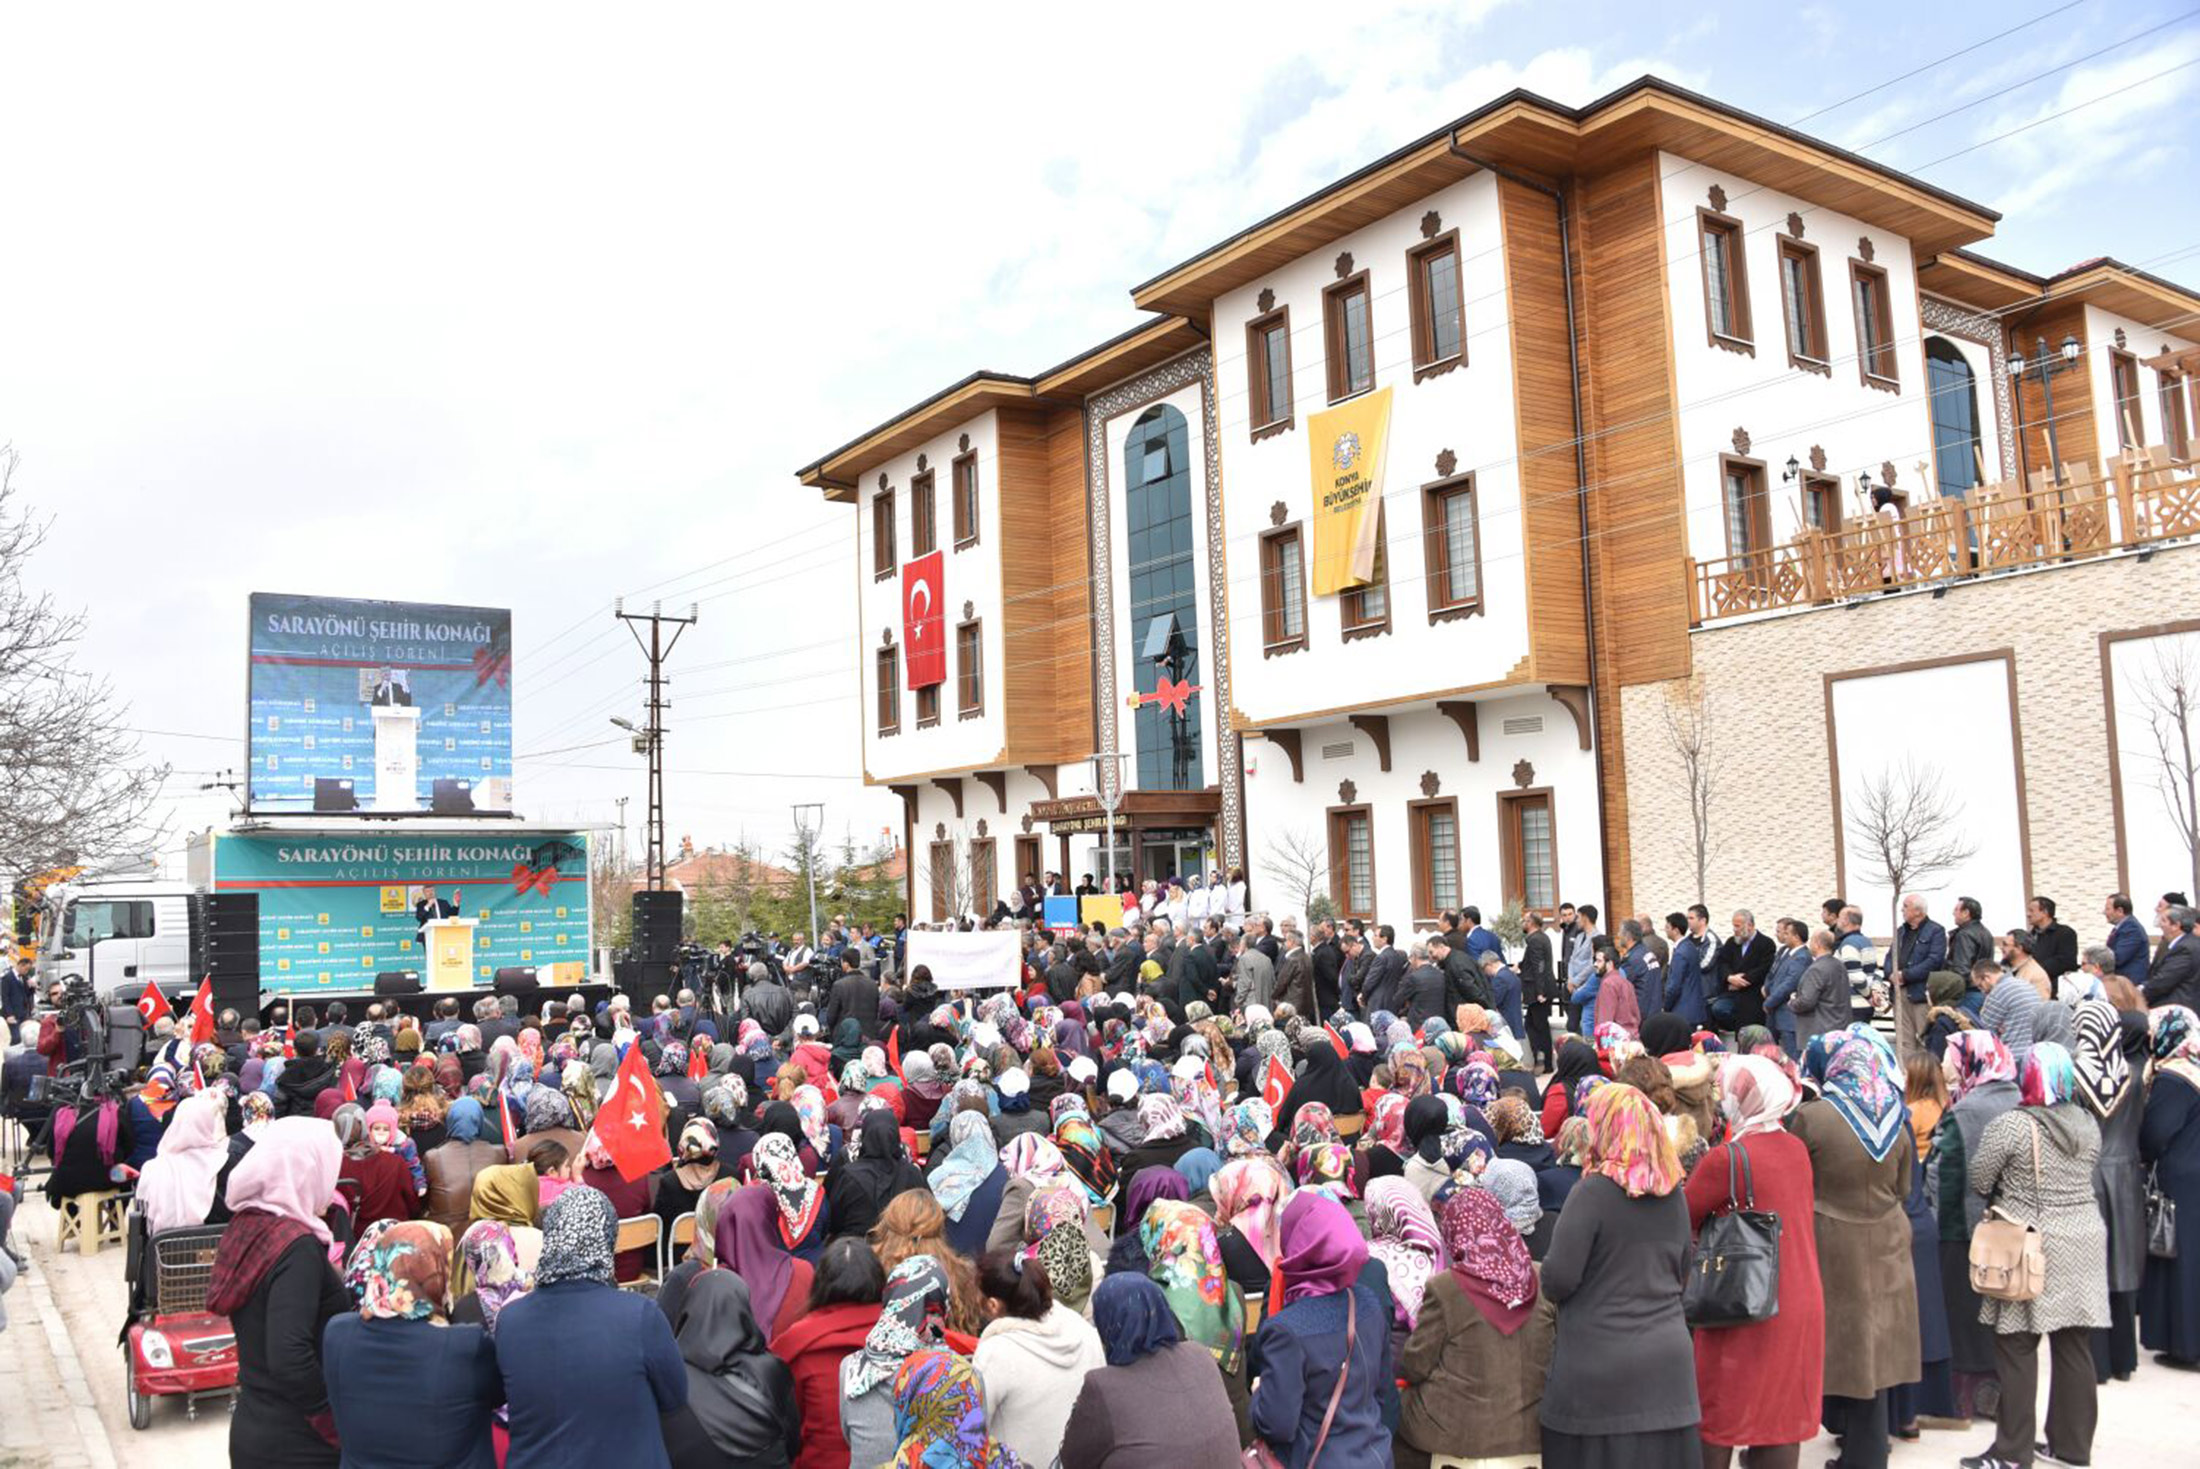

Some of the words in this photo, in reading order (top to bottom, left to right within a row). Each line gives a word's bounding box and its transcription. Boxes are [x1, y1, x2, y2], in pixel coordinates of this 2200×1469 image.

[1335, 471, 1359, 489] KONYA
[268, 614, 365, 638] SARAYÖNÜ
[369, 618, 421, 643] ŞEHİR
[425, 621, 491, 643] KONAĞI
[320, 644, 376, 662] AÇILIŞ
[278, 844, 388, 862] SARAYÖNÜ
[393, 844, 452, 865] ŞEHİR
[457, 844, 532, 861] KONAĞI
[335, 867, 399, 880] AÇILIŞ
